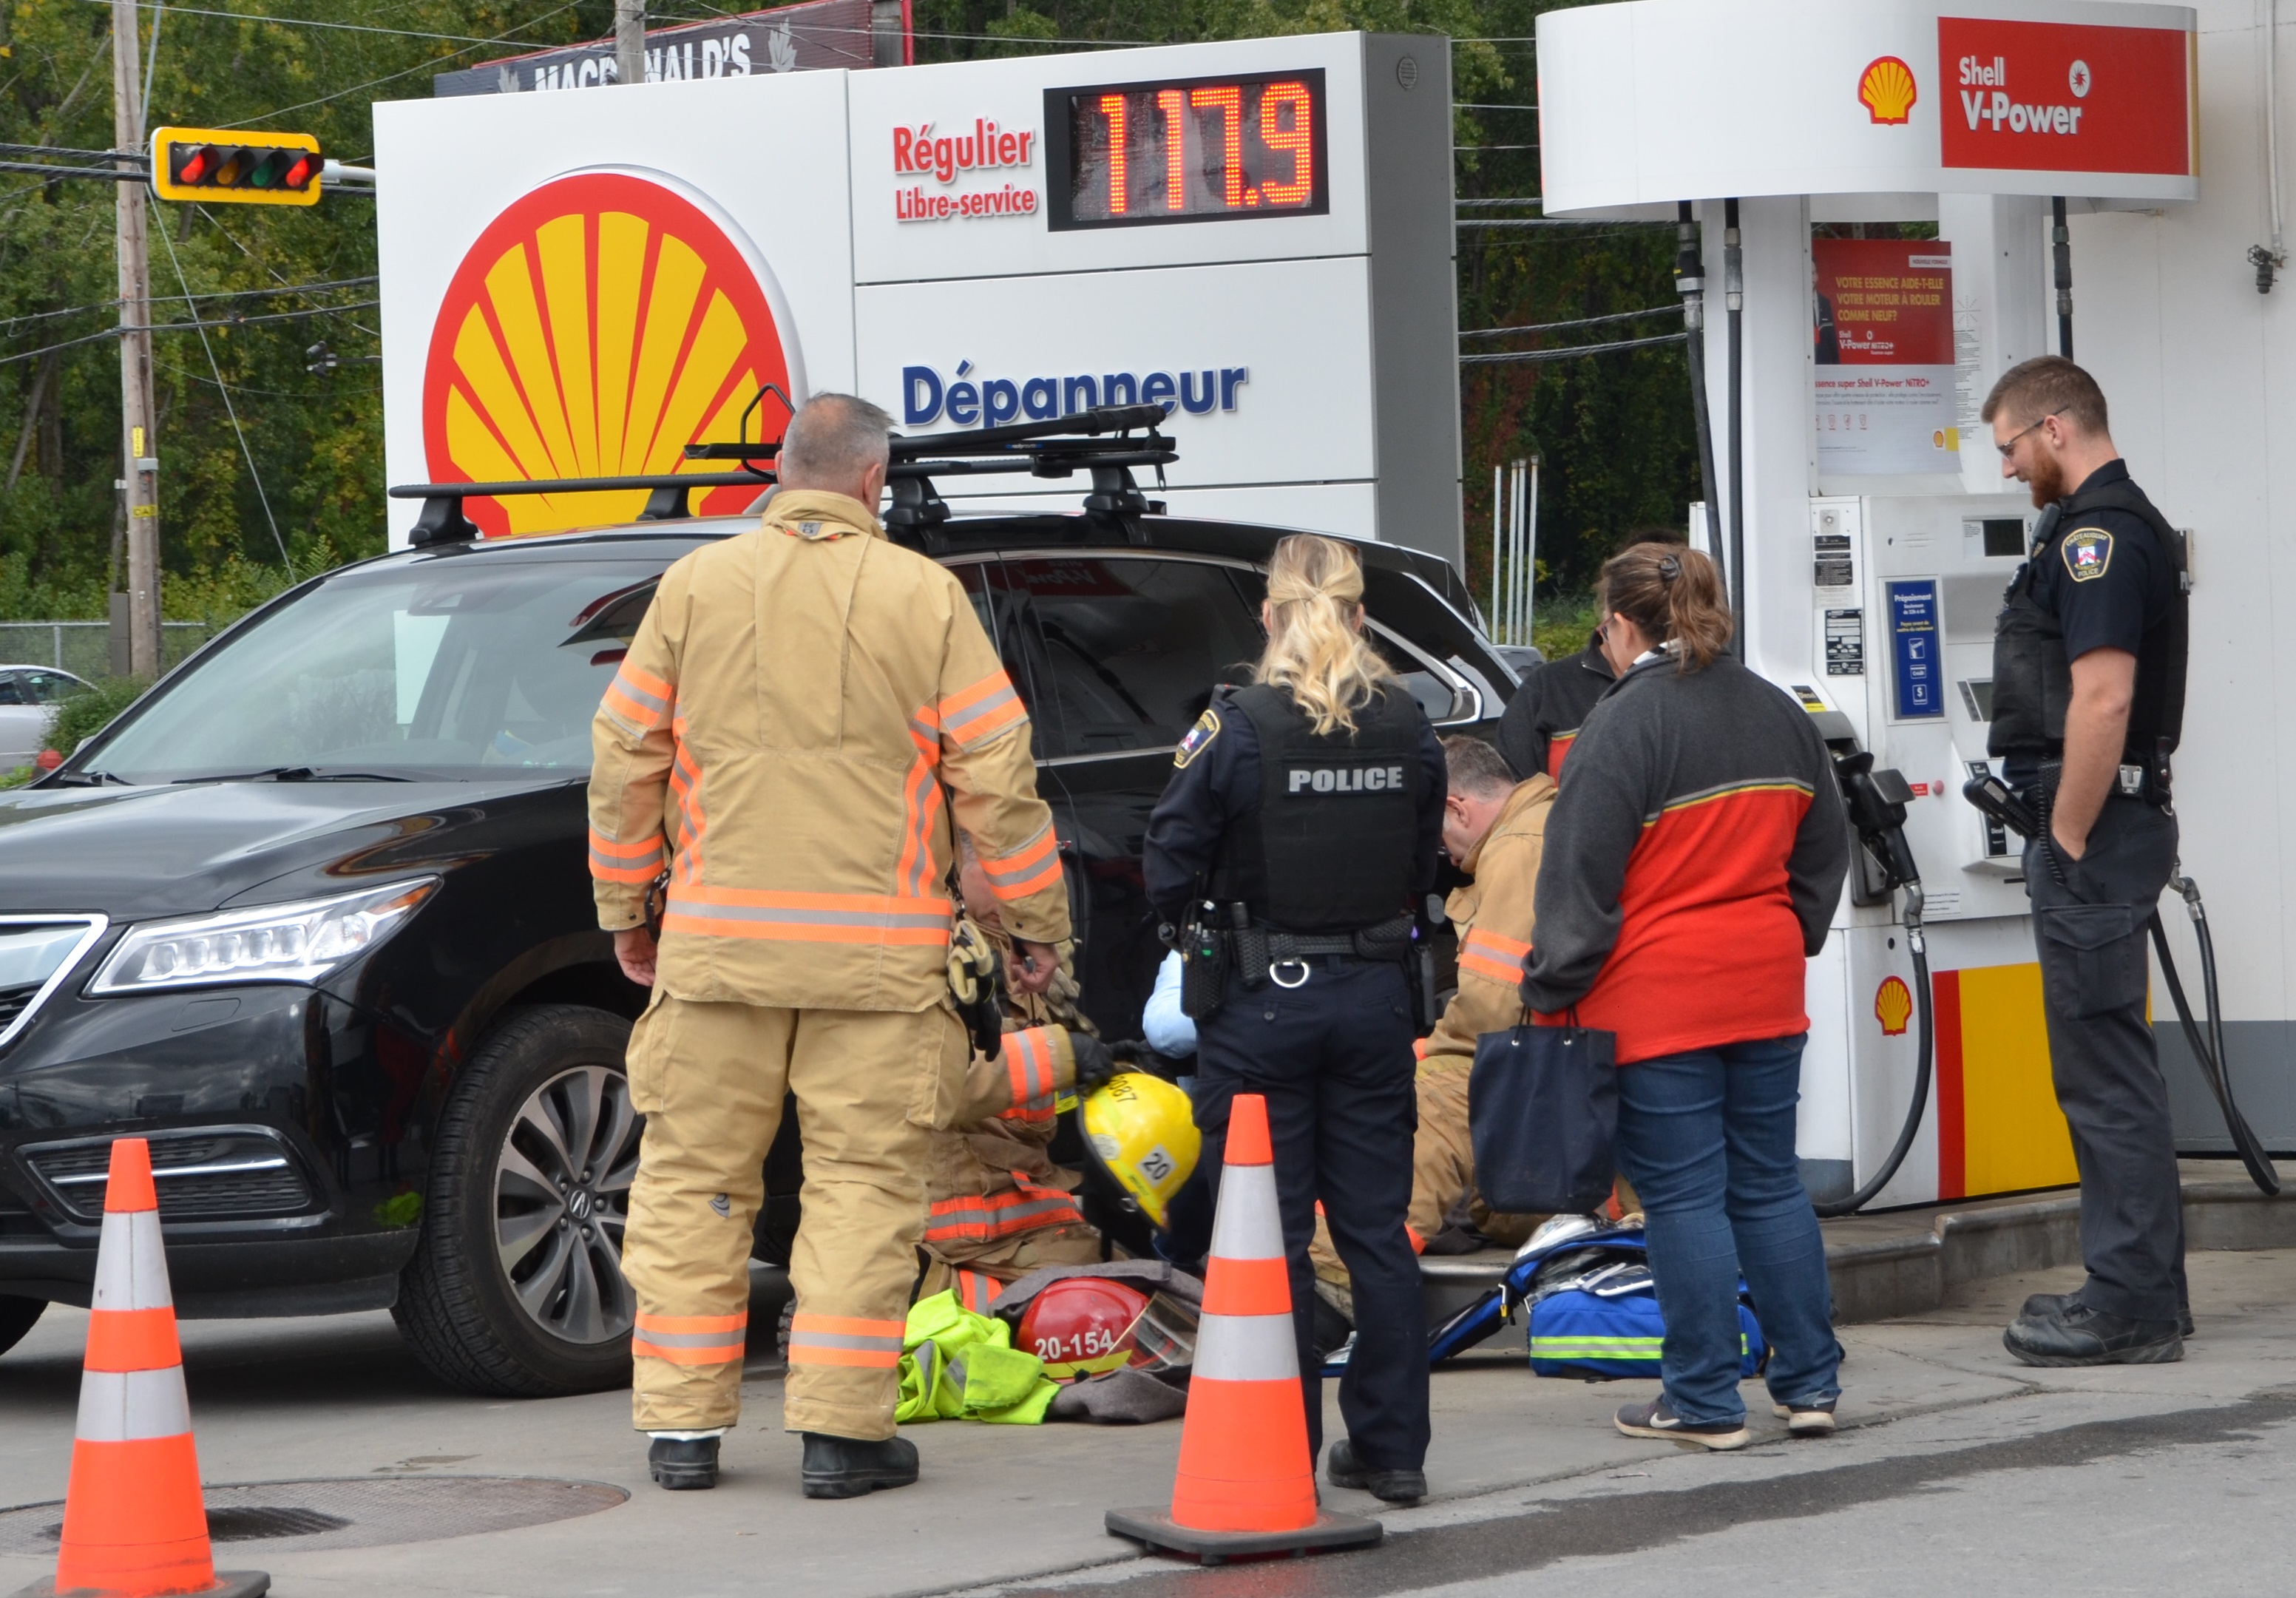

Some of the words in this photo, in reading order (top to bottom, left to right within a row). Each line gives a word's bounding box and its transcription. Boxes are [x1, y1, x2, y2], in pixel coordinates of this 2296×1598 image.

[1959, 55, 2005, 87] Shell
[1960, 90, 2082, 135] V-Power
[893, 118, 1032, 181] Régulier
[1101, 82, 1312, 213] 117.9
[895, 186, 1034, 220] Libre-service
[1835, 277, 1863, 288] VOTRE
[1865, 277, 1899, 289] ESSENCE
[1900, 278, 1943, 289] AIDE-T-ELLE
[1836, 294, 1863, 305] VOTRE
[1866, 294, 1899, 305] MOTEUR
[1902, 291, 1908, 305] À
[1910, 294, 1940, 305] ROULER
[1838, 310, 1869, 321] COMME
[1872, 310, 1897, 321] NEUF?
[1839, 339, 1870, 349] V-Power
[902, 358, 1246, 429] Dépanneur
[1815, 380, 1835, 388] ssence
[1838, 381, 1856, 390] super
[1858, 378, 1872, 387] Shell
[1875, 379, 1902, 387] V-Power
[2078, 568, 2099, 578] POLICE
[1894, 594, 1931, 603] Prépaiement
[1289, 767, 1402, 792] POLICE
[1142, 1153, 1170, 1180] 20
[1035, 1329, 1114, 1360] 20-154
